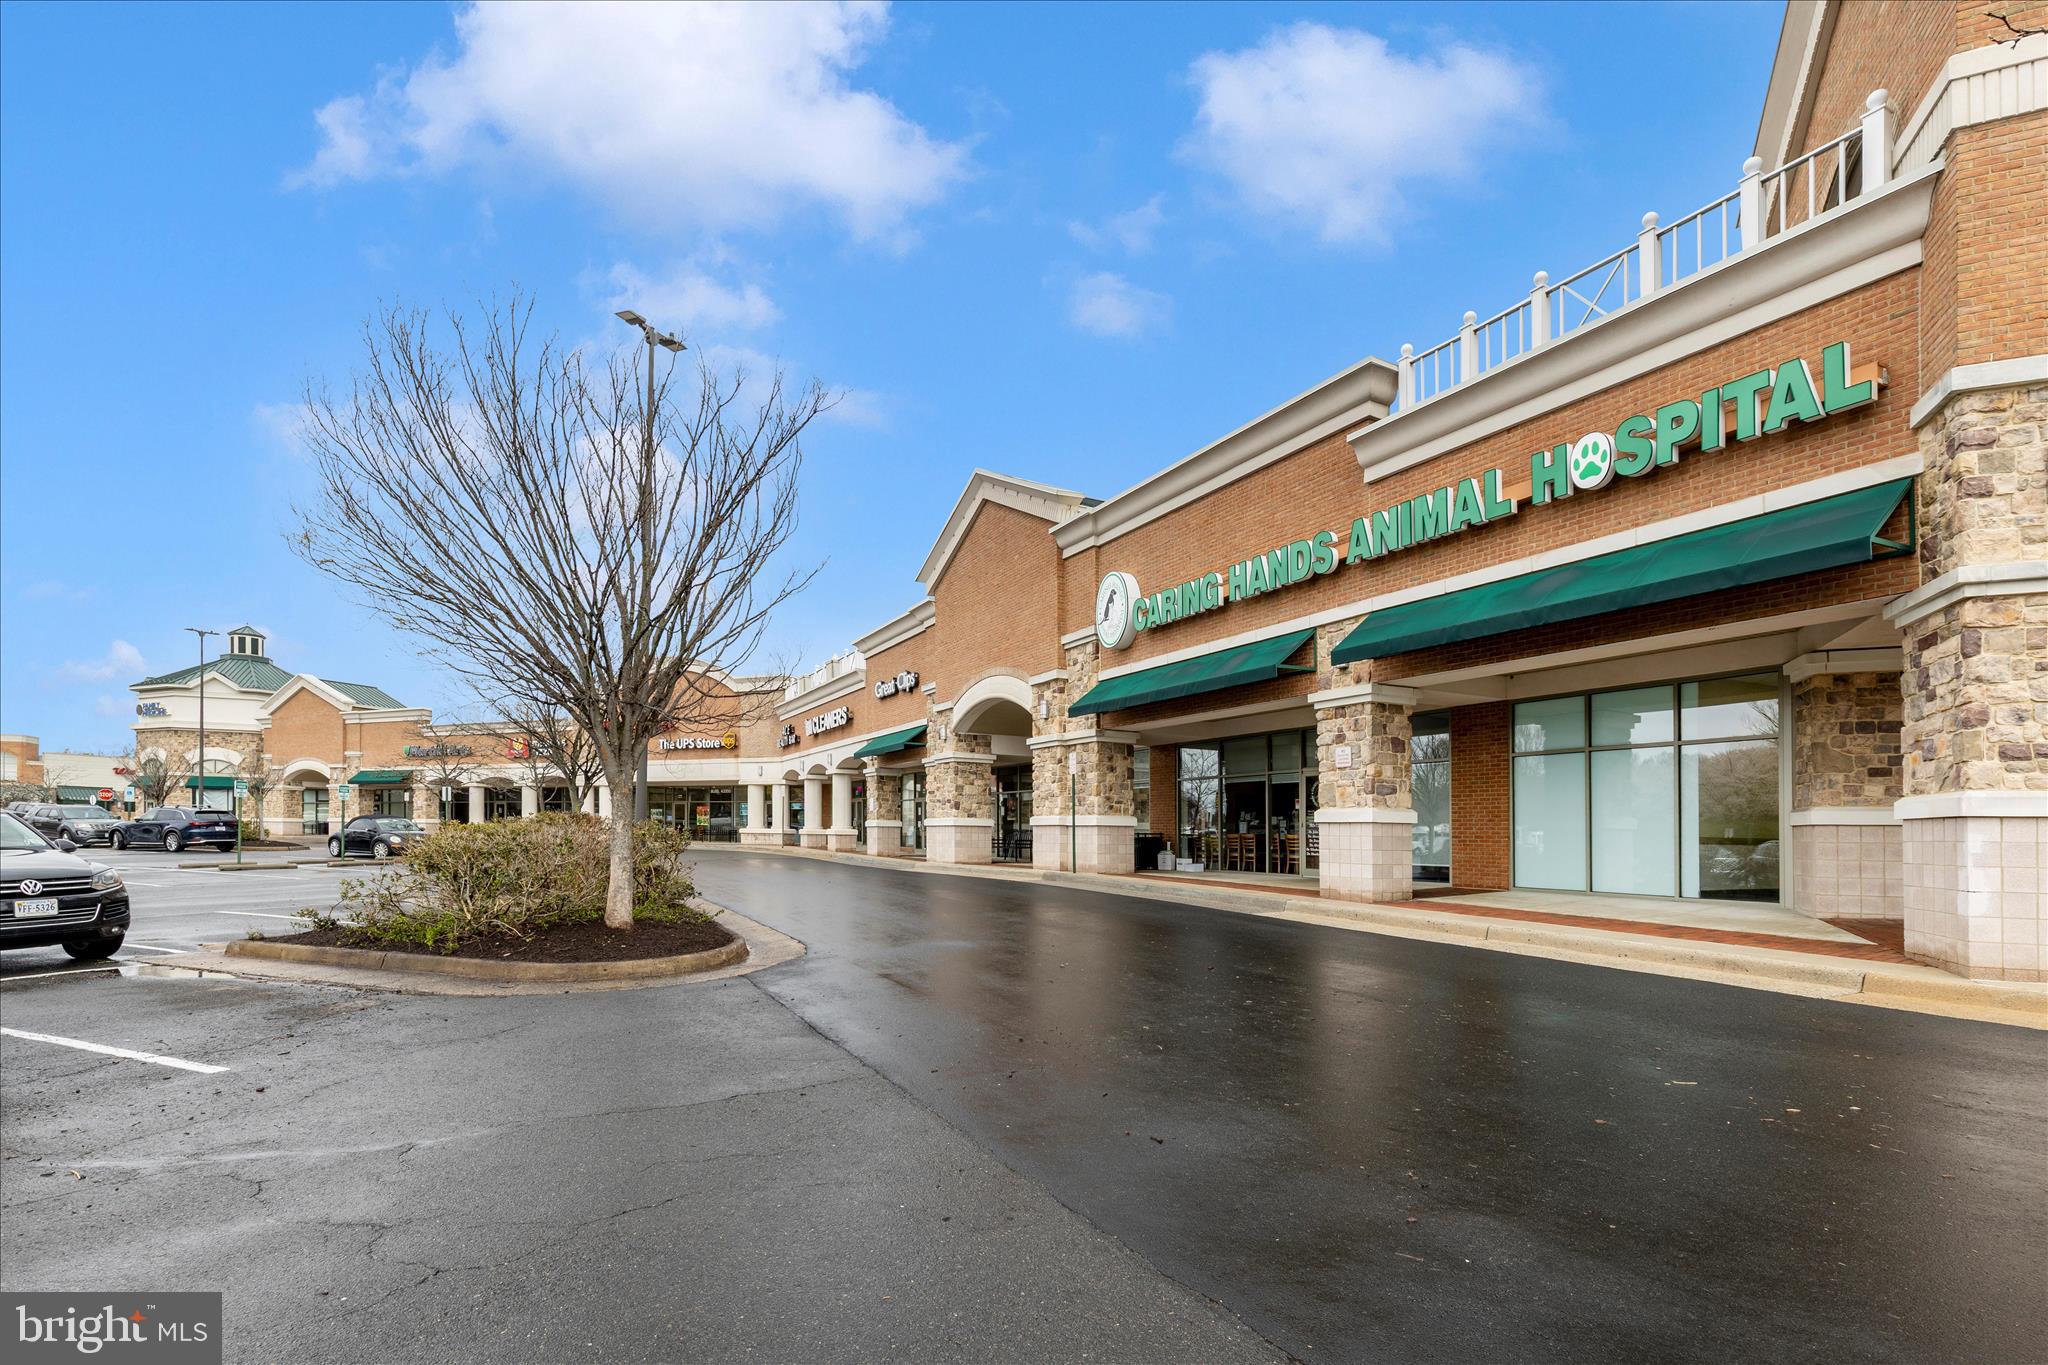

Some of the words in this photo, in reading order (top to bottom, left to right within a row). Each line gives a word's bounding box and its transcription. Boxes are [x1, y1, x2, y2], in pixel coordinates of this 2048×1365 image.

[1133, 571, 1222, 632] CARING
[1228, 530, 1337, 602] HANDS
[1346, 468, 1515, 565] ANIMAL
[875, 677, 896, 699] Great
[897, 671, 918, 692] Clips
[812, 706, 849, 734] CLEANERS
[660, 739, 674, 750] The
[676, 738, 694, 749] UPS
[696, 738, 720, 749] Store
